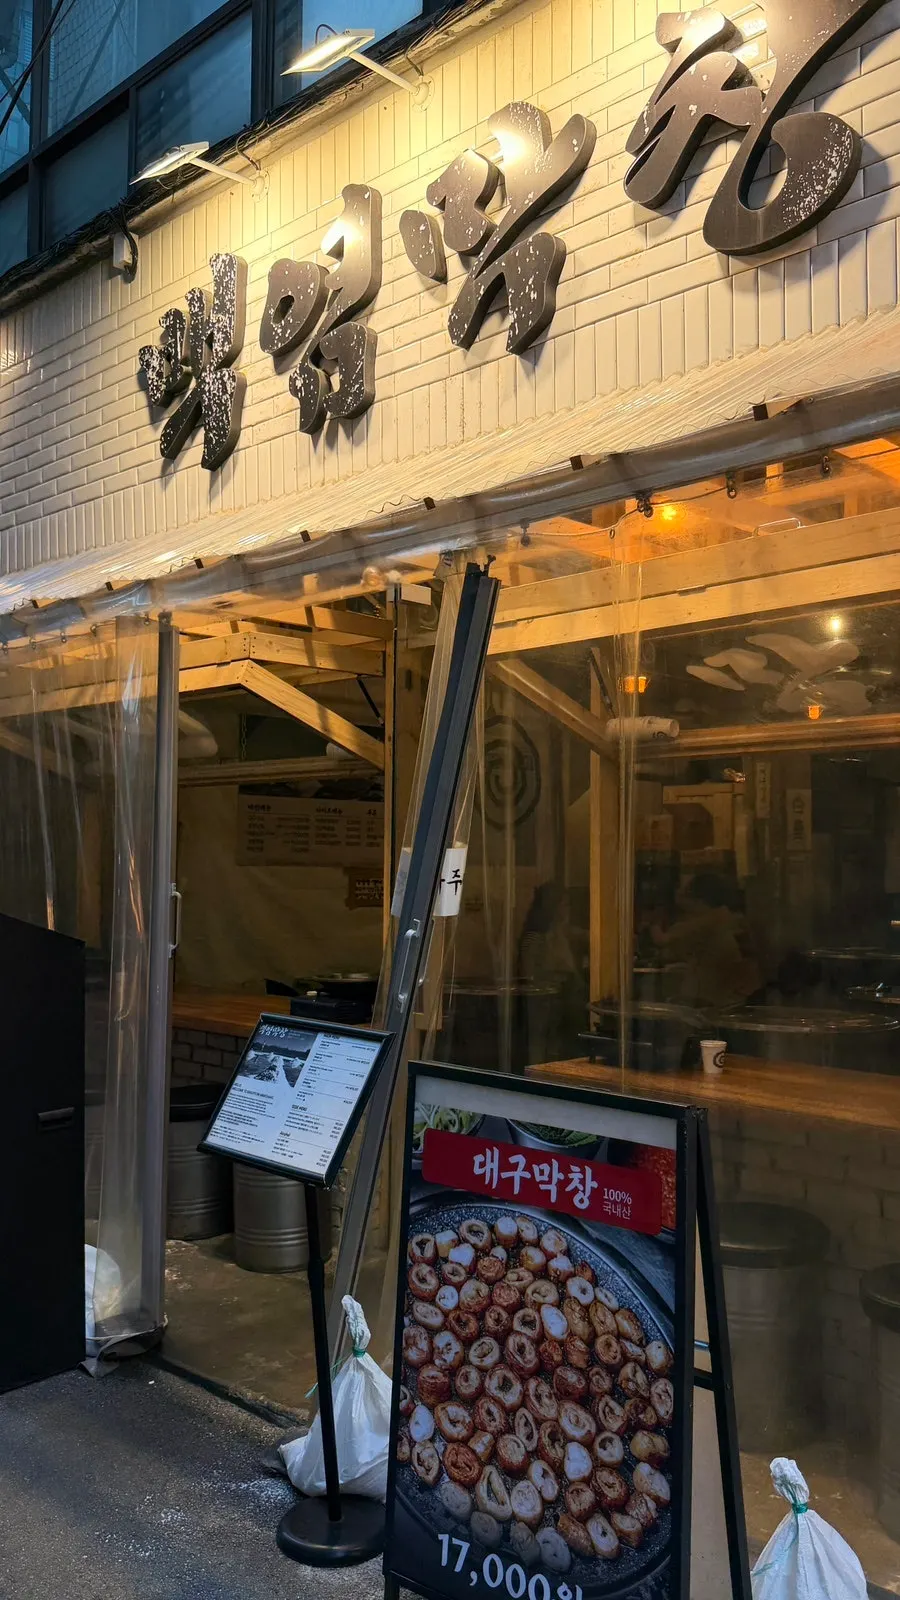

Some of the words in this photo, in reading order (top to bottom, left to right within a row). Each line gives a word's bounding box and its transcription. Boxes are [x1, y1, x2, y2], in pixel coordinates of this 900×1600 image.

[473, 1146, 599, 1210] 대구막창
[603, 1187, 633, 1205] 100%
[603, 1201, 632, 1220] 국내산
